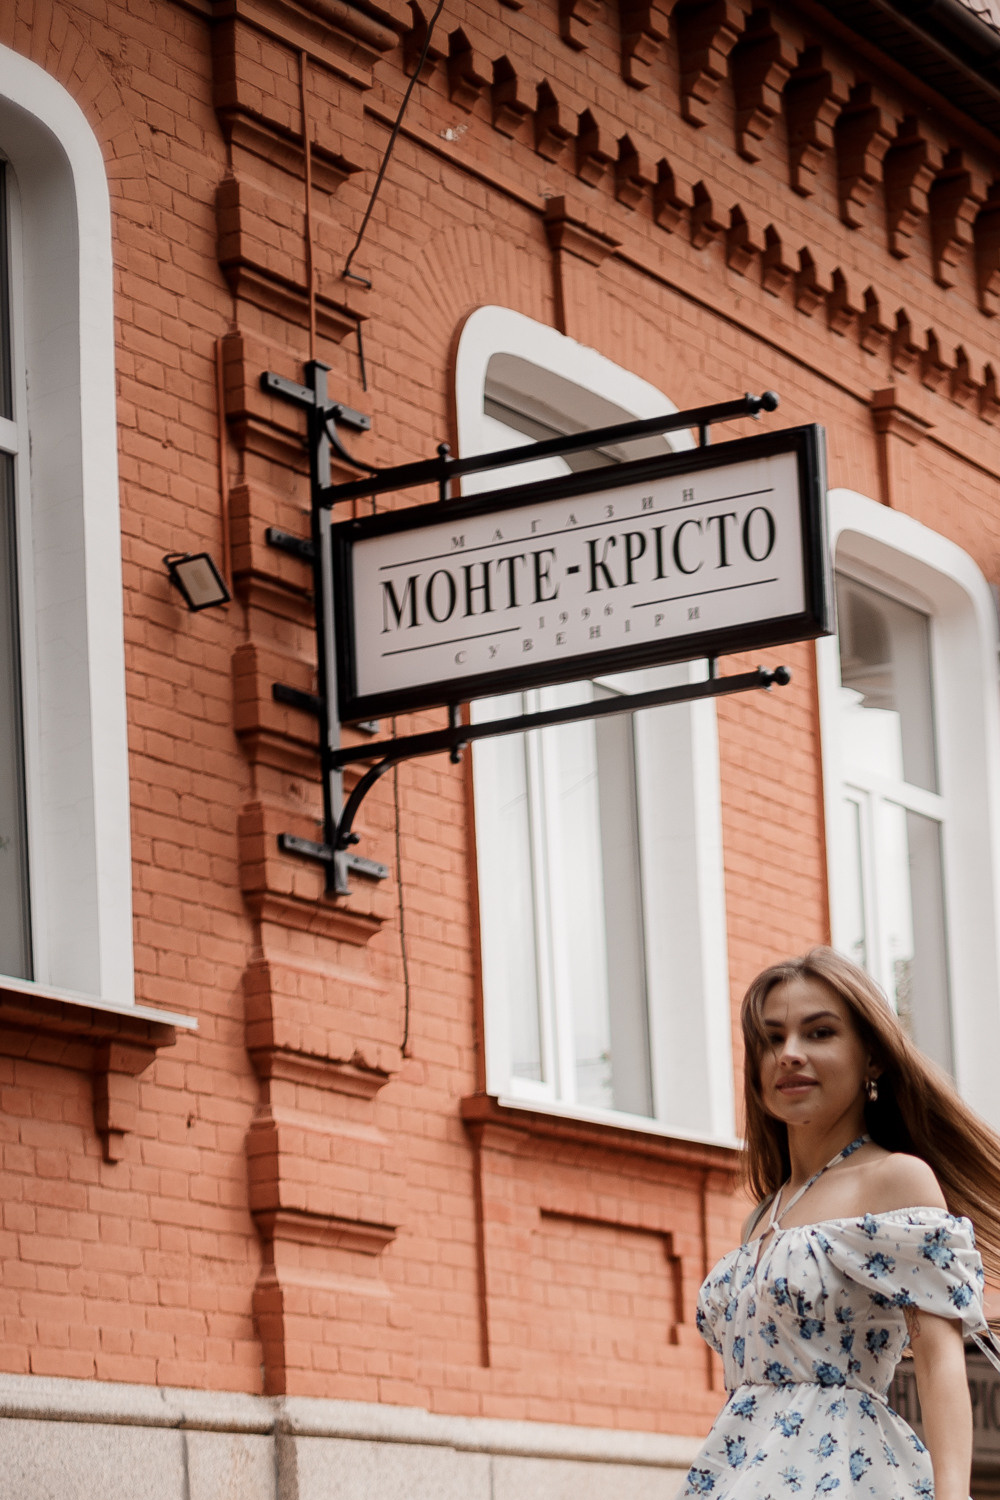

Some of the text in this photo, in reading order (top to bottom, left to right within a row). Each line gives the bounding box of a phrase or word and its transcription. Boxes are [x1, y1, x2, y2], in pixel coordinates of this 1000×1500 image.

[451, 487, 695, 549] МАГАЗИН
[379, 506, 777, 635] МОНТЕ-КРІСТО
[453, 606, 701, 665] СУВЕНІРИ
[538, 603, 614, 630] 1996
